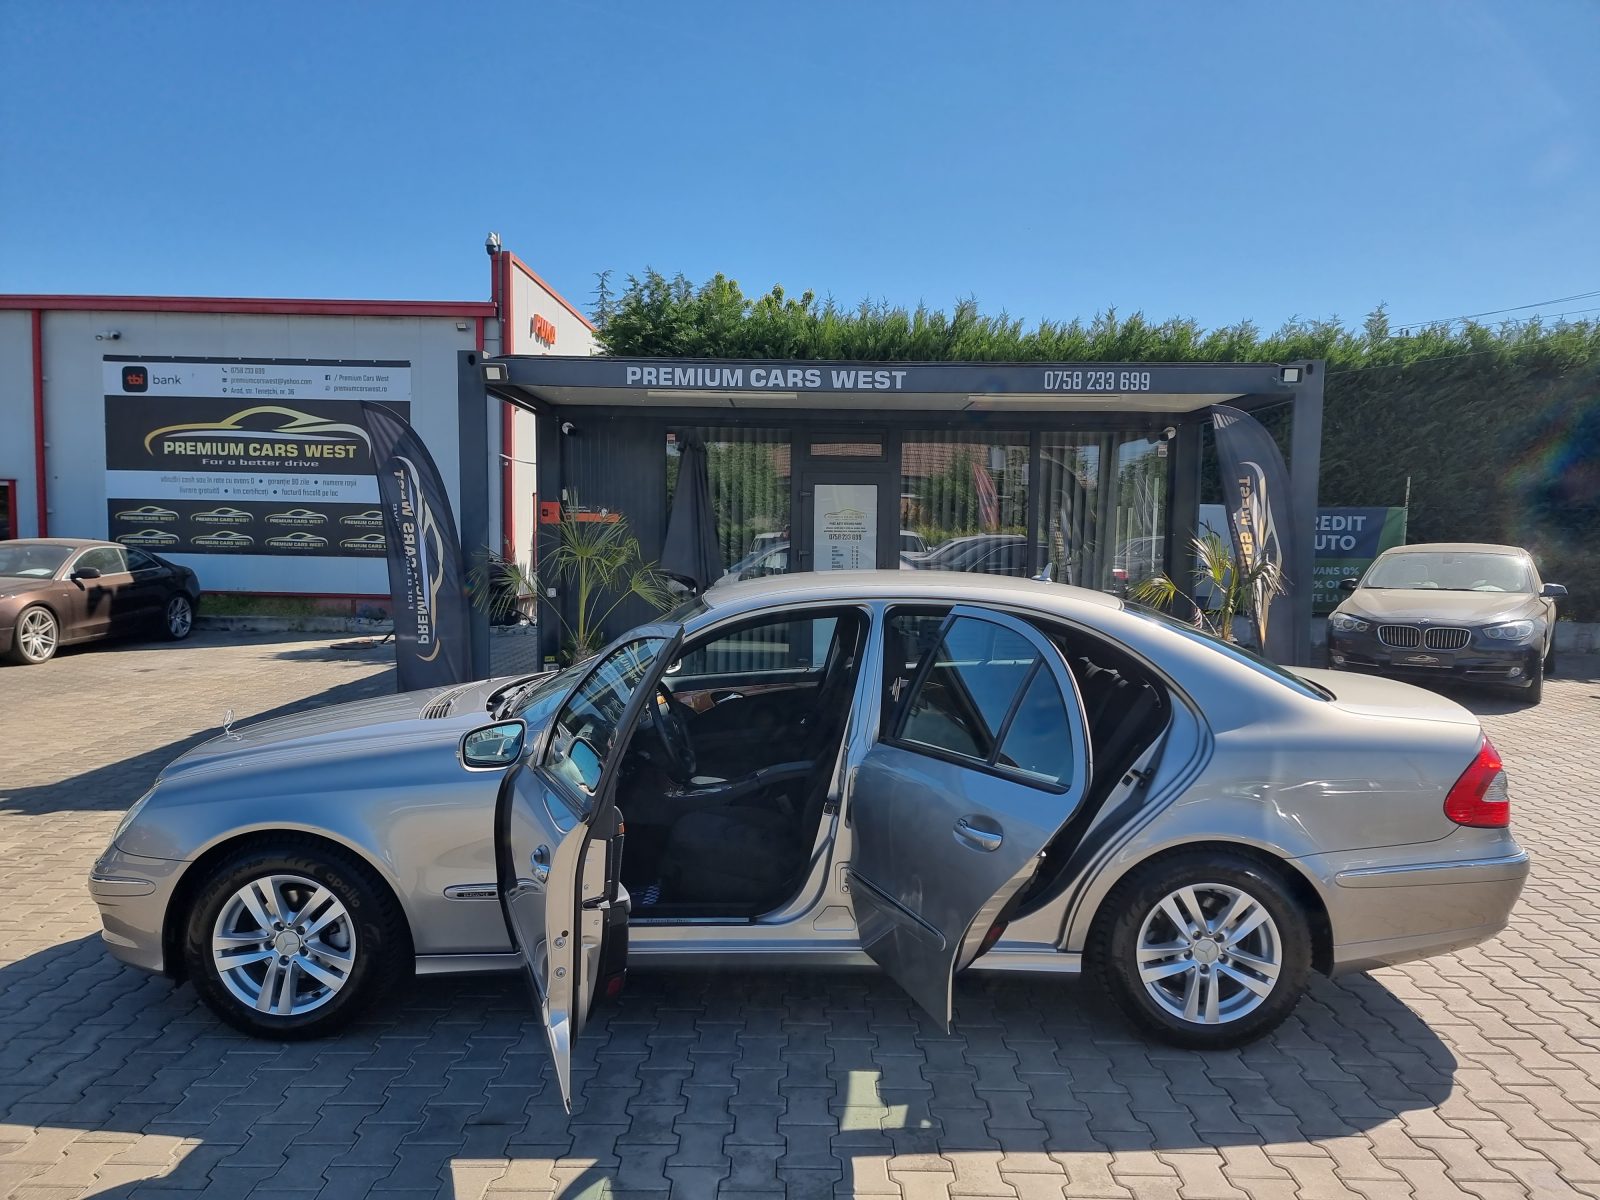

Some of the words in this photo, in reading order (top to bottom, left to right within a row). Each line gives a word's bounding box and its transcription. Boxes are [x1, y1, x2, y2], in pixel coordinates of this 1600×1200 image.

[127, 374, 145, 385] tbi
[153, 374, 182, 385] bank
[626, 366, 743, 387] PREMIUM
[749, 368, 822, 388] CARS
[831, 370, 907, 389] WEST
[1044, 371, 1082, 390] 0758
[1086, 371, 1115, 390] 233
[1119, 372, 1151, 391] 699
[163, 441, 244, 456] PREMIUM
[248, 443, 299, 457] CARS
[304, 444, 357, 458] WEST
[240, 459, 281, 467] better
[1315, 515, 1367, 531] EDIT
[1314, 534, 1356, 551] UTO
[1342, 566, 1360, 576] 0%
[326, 872, 361, 908] apollo
